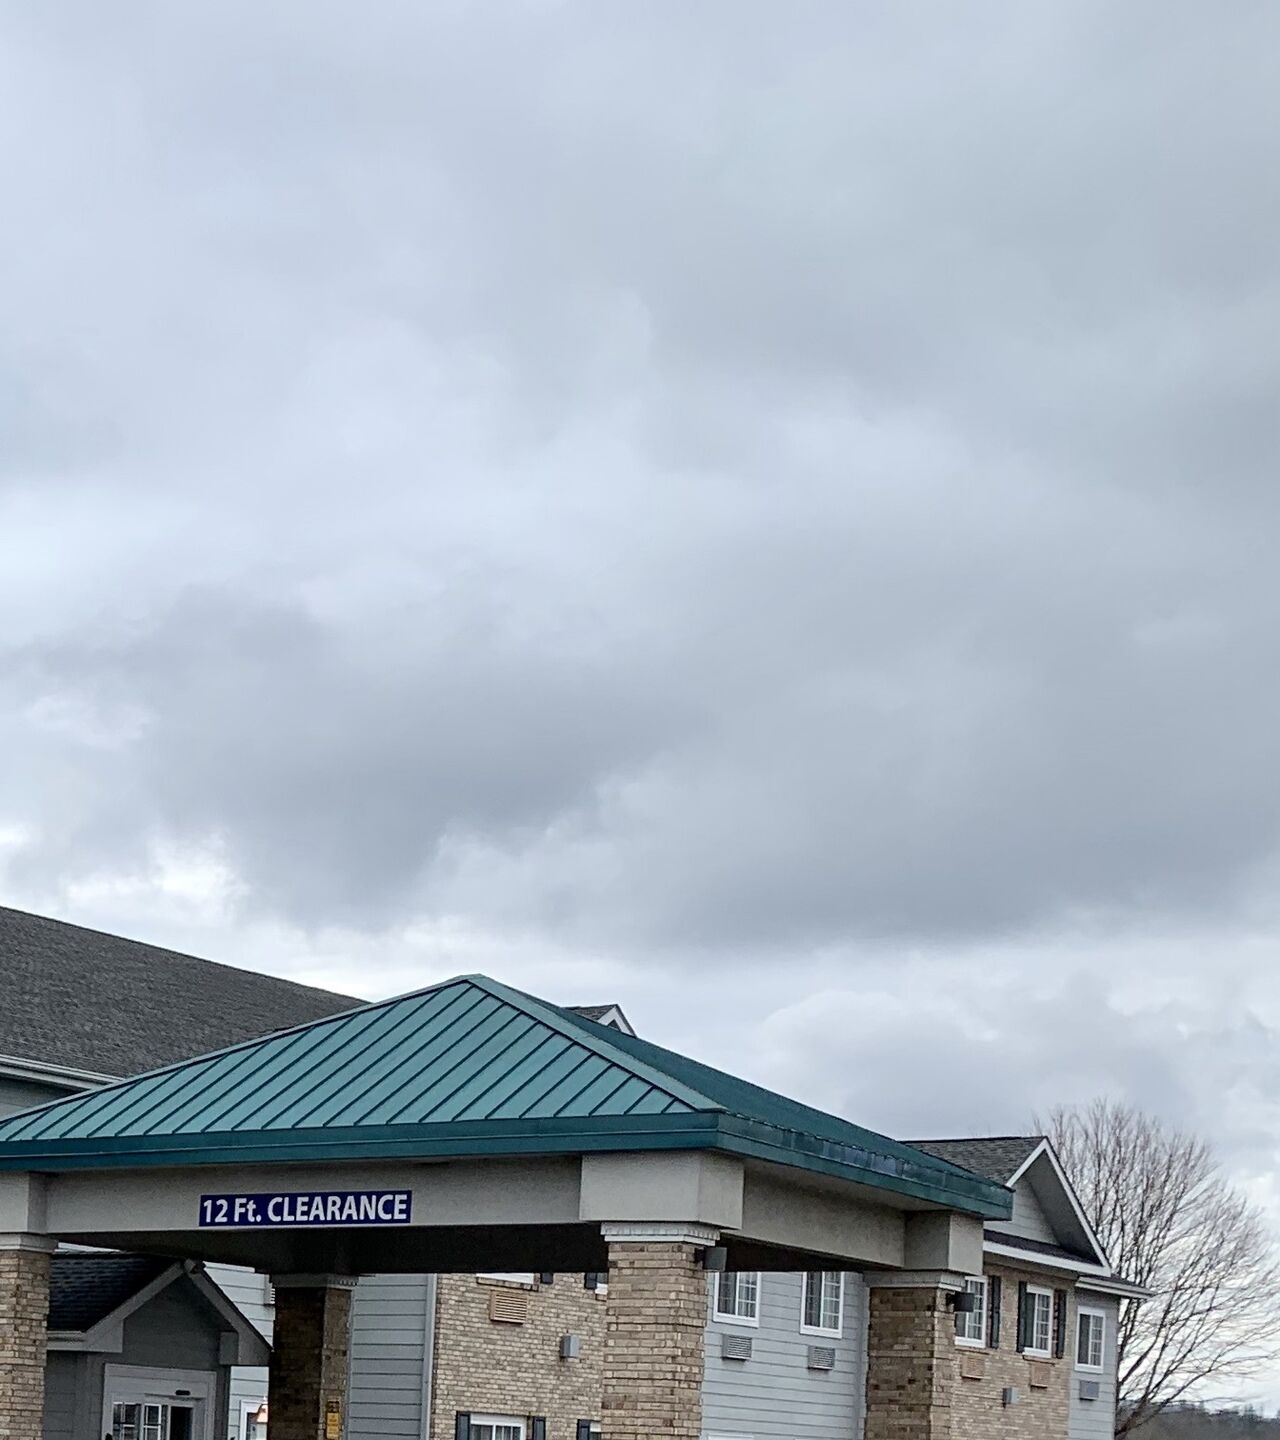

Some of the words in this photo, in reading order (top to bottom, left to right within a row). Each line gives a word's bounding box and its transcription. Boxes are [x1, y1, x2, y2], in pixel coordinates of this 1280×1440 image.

[203, 1199, 228, 1223] 12
[234, 1197, 262, 1223] Ft.
[267, 1194, 408, 1222] CLEARANCE
